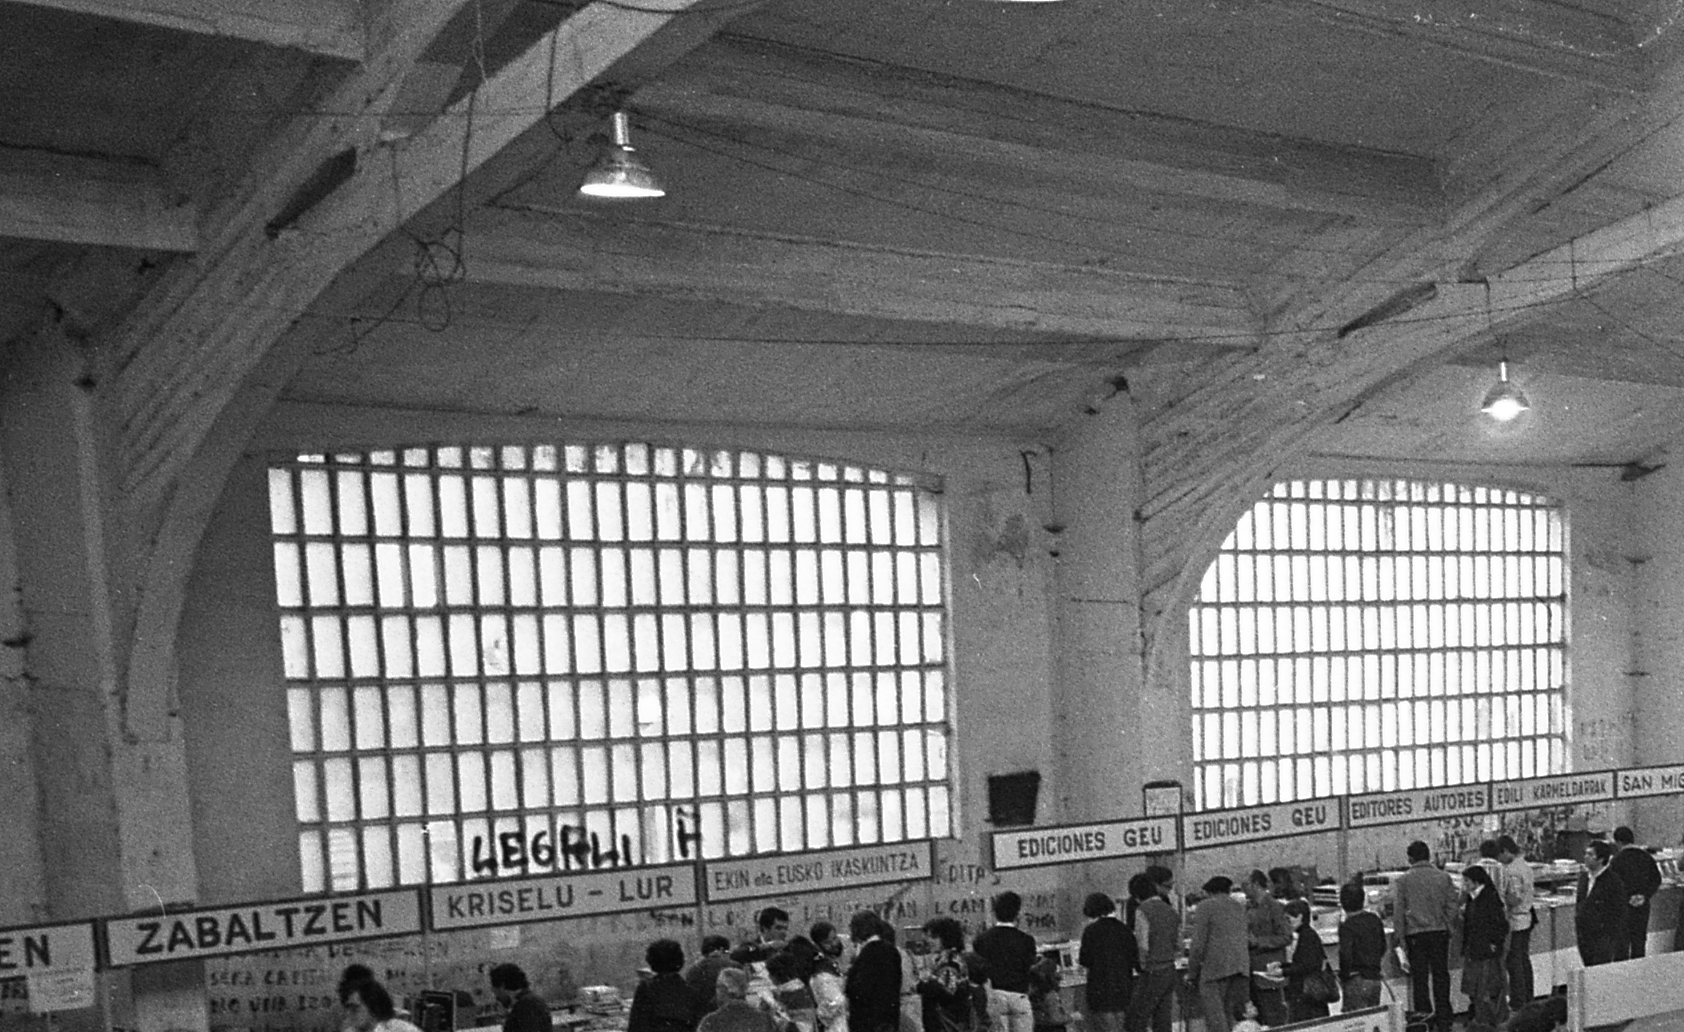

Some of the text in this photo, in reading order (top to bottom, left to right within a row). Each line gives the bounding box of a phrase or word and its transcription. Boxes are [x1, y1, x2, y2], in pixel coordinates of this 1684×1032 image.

[1622, 775, 1653, 793] SAN
[1193, 805, 1327, 842] EDICIONES GEU
[1351, 790, 1485, 821] EDITORES AUTORES
[1017, 824, 1163, 859] EDICIONES GEU
[714, 869, 750, 892] EKIN
[776, 861, 824, 885] EUSKO
[831, 852, 919, 878] IKASKUNTZA
[447, 884, 575, 919] KRISELU
[619, 875, 675, 902] LUR
[134, 899, 384, 955] ZABALTZEN
